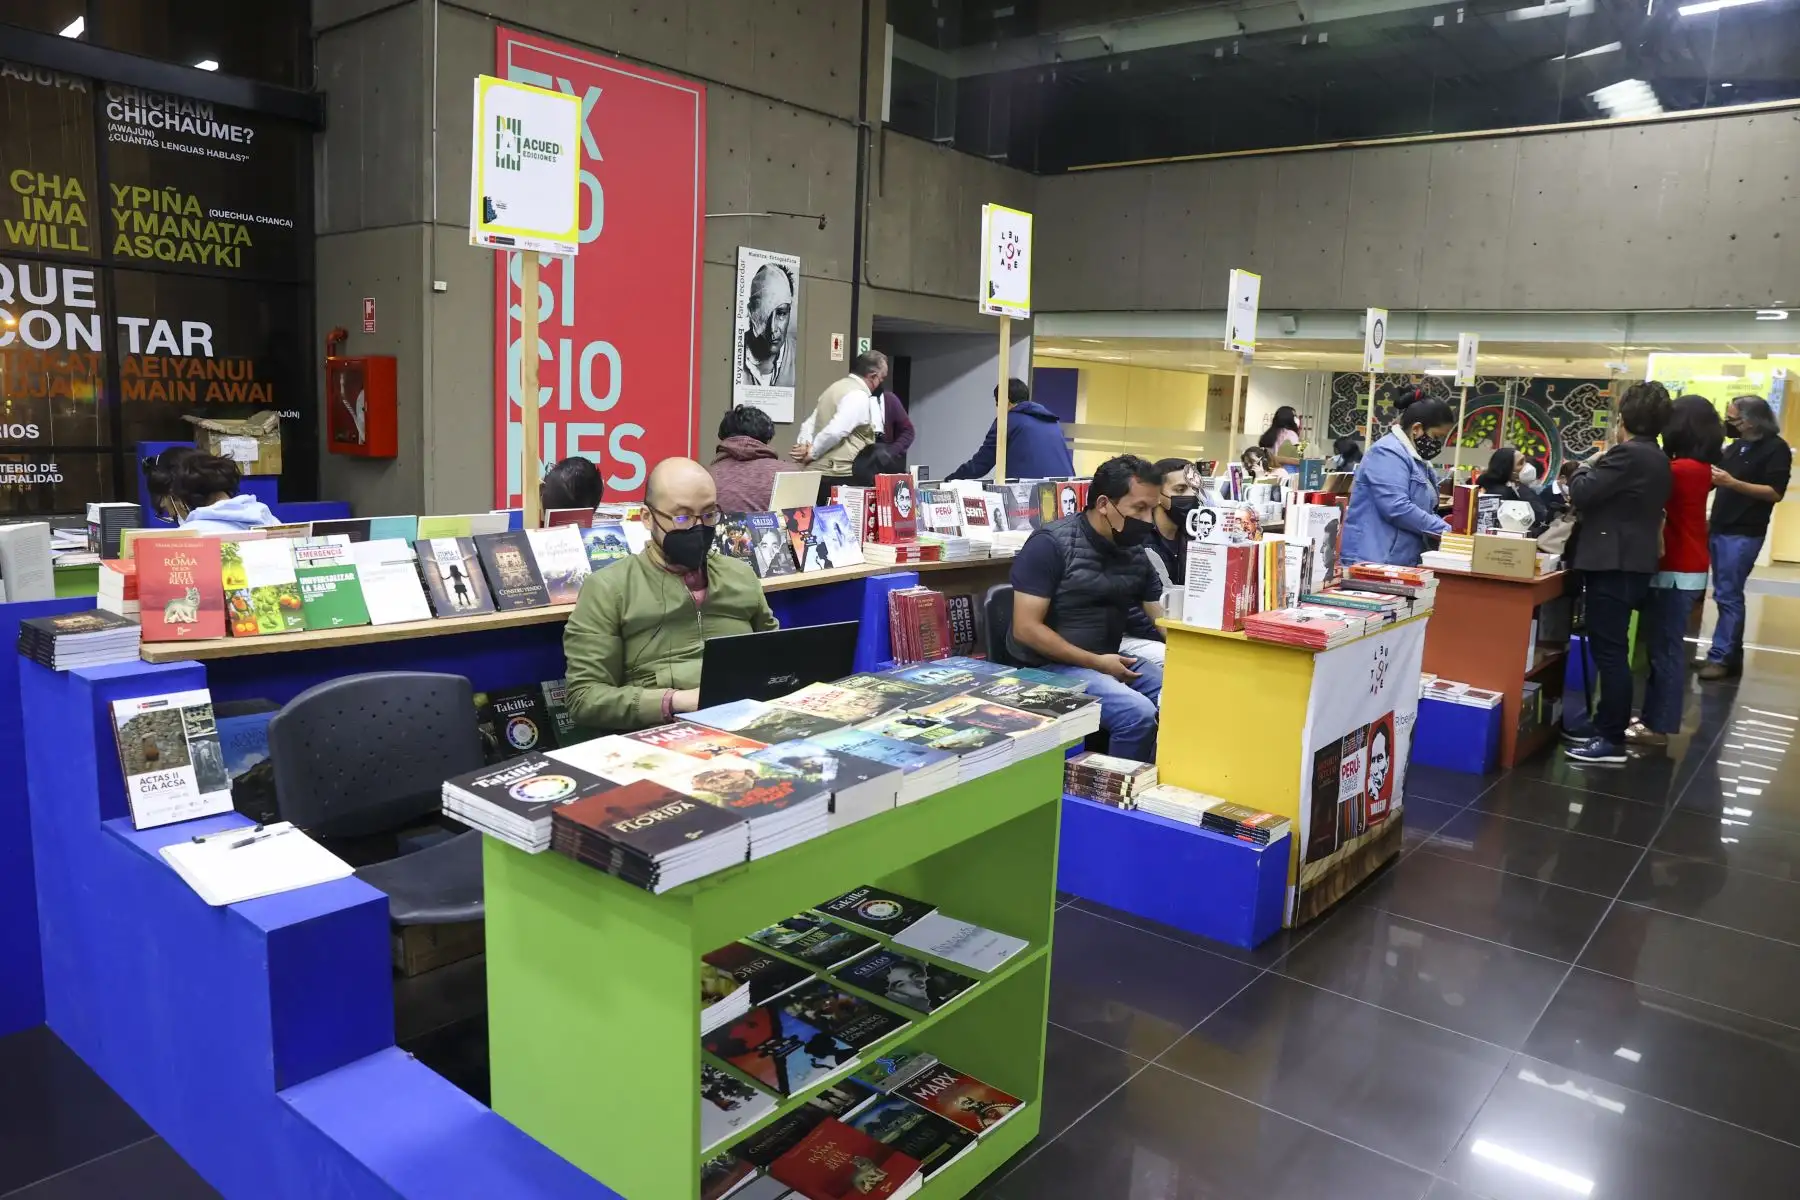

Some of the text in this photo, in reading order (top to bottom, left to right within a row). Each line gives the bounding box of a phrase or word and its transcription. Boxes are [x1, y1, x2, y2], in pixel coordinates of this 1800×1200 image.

[106, 102, 255, 144] CHICHAUME?
[108, 122, 155, 139] (AWAJÚN)
[108, 133, 159, 149] ¿CUÁNTAS
[161, 140, 205, 155] LENGUAS
[523, 151, 557, 163] EDICIONES
[10, 169, 87, 203] CHA
[110, 182, 203, 218] YPIÑA
[23, 197, 88, 228] IMA
[208, 208, 293, 229] (QUECHUA CHANCA)
[4, 219, 90, 252] WILL
[111, 208, 252, 247] YMANATA
[112, 233, 241, 268] ASQAYKI
[748, 251, 797, 265] Muestra fotográfica
[737, 298, 745, 320] Para
[117, 316, 214, 358] TAR
[861, 339, 869, 352] S
[735, 327, 745, 386] Yuyanapaq
[121, 355, 254, 381] AEIYANUI
[508, 338, 622, 412] CIO
[121, 379, 273, 404] MAIN AWAI
[40, 463, 58, 474] DE
[164, 557, 199, 568] ROMA
[299, 548, 343, 559] EMERGENCIA
[169, 577, 195, 585] REYES
[302, 584, 312, 593] LA
[949, 597, 969, 610] POD
[950, 608, 971, 621] ERE
[953, 619, 972, 632] SSE
[954, 631, 974, 644] CRE
[493, 699, 536, 713] Takilka
[140, 772, 170, 786] ACTAS
[471, 759, 551, 789] Takilka
[140, 778, 186, 793] CIA ACSA
[614, 801, 697, 835] FLORIDA
[828, 888, 870, 912] Takilka
[853, 955, 890, 978] GRITOS
[840, 1013, 882, 1038] HABLANDO
[914, 1071, 958, 1101] MARX
[808, 1141, 838, 1164] ROMA
